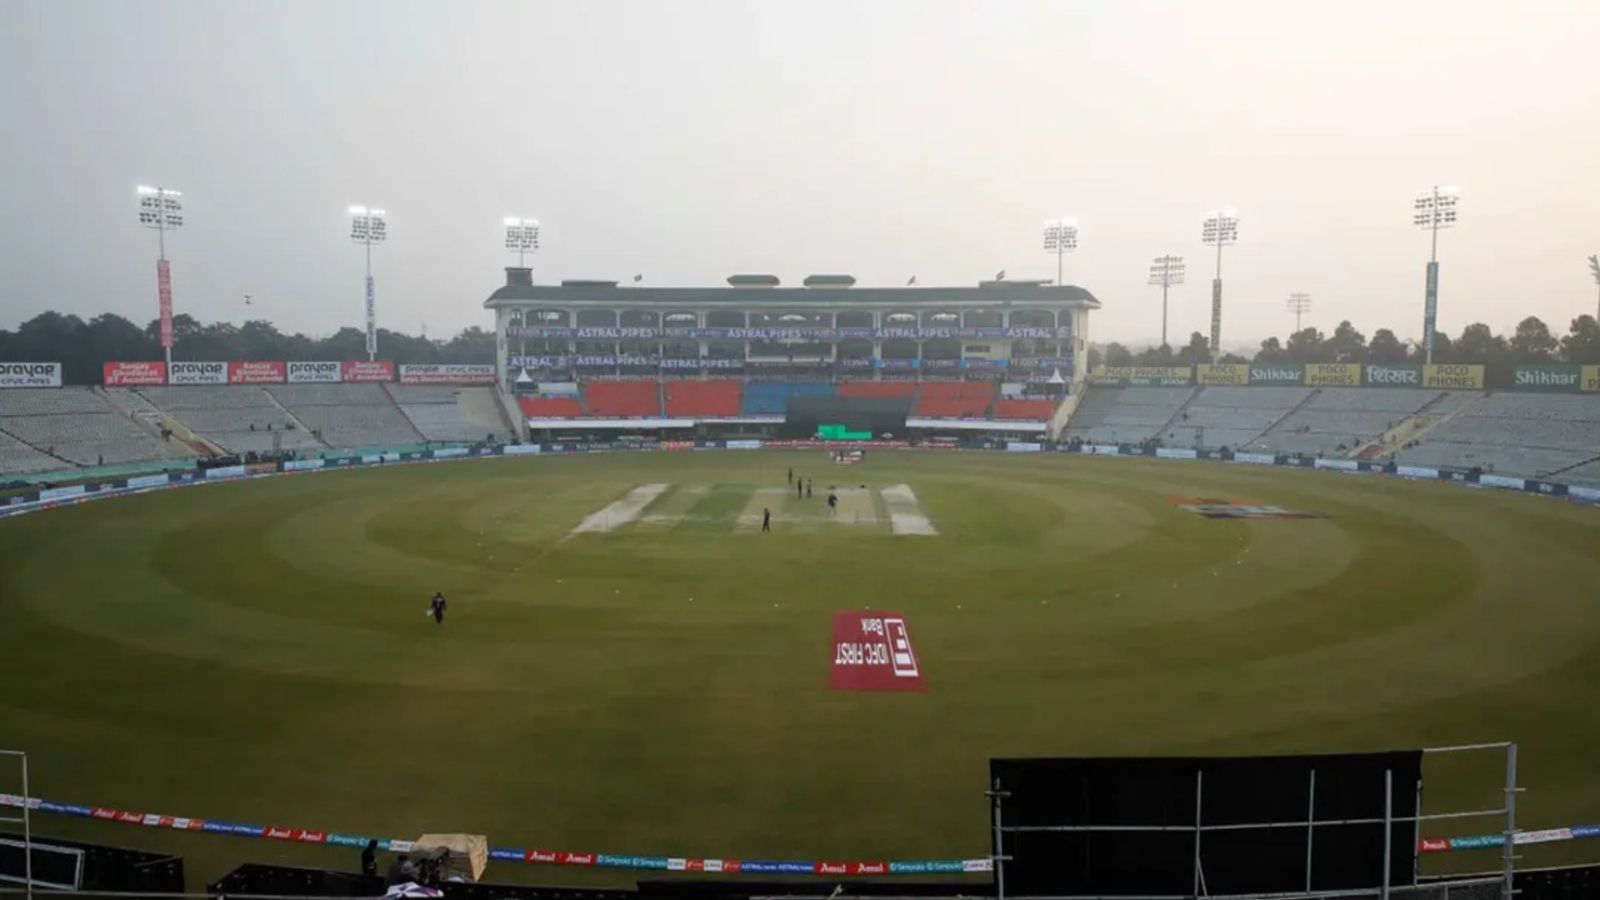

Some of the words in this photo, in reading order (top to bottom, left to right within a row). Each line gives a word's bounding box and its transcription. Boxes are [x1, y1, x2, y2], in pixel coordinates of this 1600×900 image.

[577, 328, 618, 338] ASTRAL
[620, 328, 653, 338] PIPES
[728, 329, 769, 338] ASTRAL
[770, 329, 803, 338] PIPES
[875, 328, 916, 338] ASTRAL
[919, 328, 950, 338] PIPES
[1007, 328, 1051, 338] ASTRAL
[511, 357, 552, 367] ASTRAL
[576, 356, 617, 366] ASTRAL
[618, 355, 647, 366] PIPES
[660, 359, 698, 368] ASTRAL
[700, 359, 730, 368] PIPES
[1209, 366, 1236, 374] POCO
[1252, 367, 1302, 380] Shikhar
[1318, 365, 1347, 374] POCO
[1366, 365, 1418, 384] शिखर
[1437, 366, 1469, 376] POCO
[1202, 374, 1243, 384] PHONES
[1311, 374, 1355, 385] PHONES
[1429, 376, 1476, 387] PHONES
[1515, 370, 1578, 385] Shikhar
[861, 618, 884, 636] Bank
[835, 643, 864, 665] FIRST
[865, 643, 889, 665] IDFC
[95, 808, 115, 818] Amul
[120, 811, 144, 822] Amul
[268, 828, 291, 838] Amul
[298, 830, 323, 841] Amul
[530, 851, 556, 862] Amul
[565, 853, 591, 863] Amul
[821, 862, 846, 873] Amul
[858, 862, 884, 873] Amul
